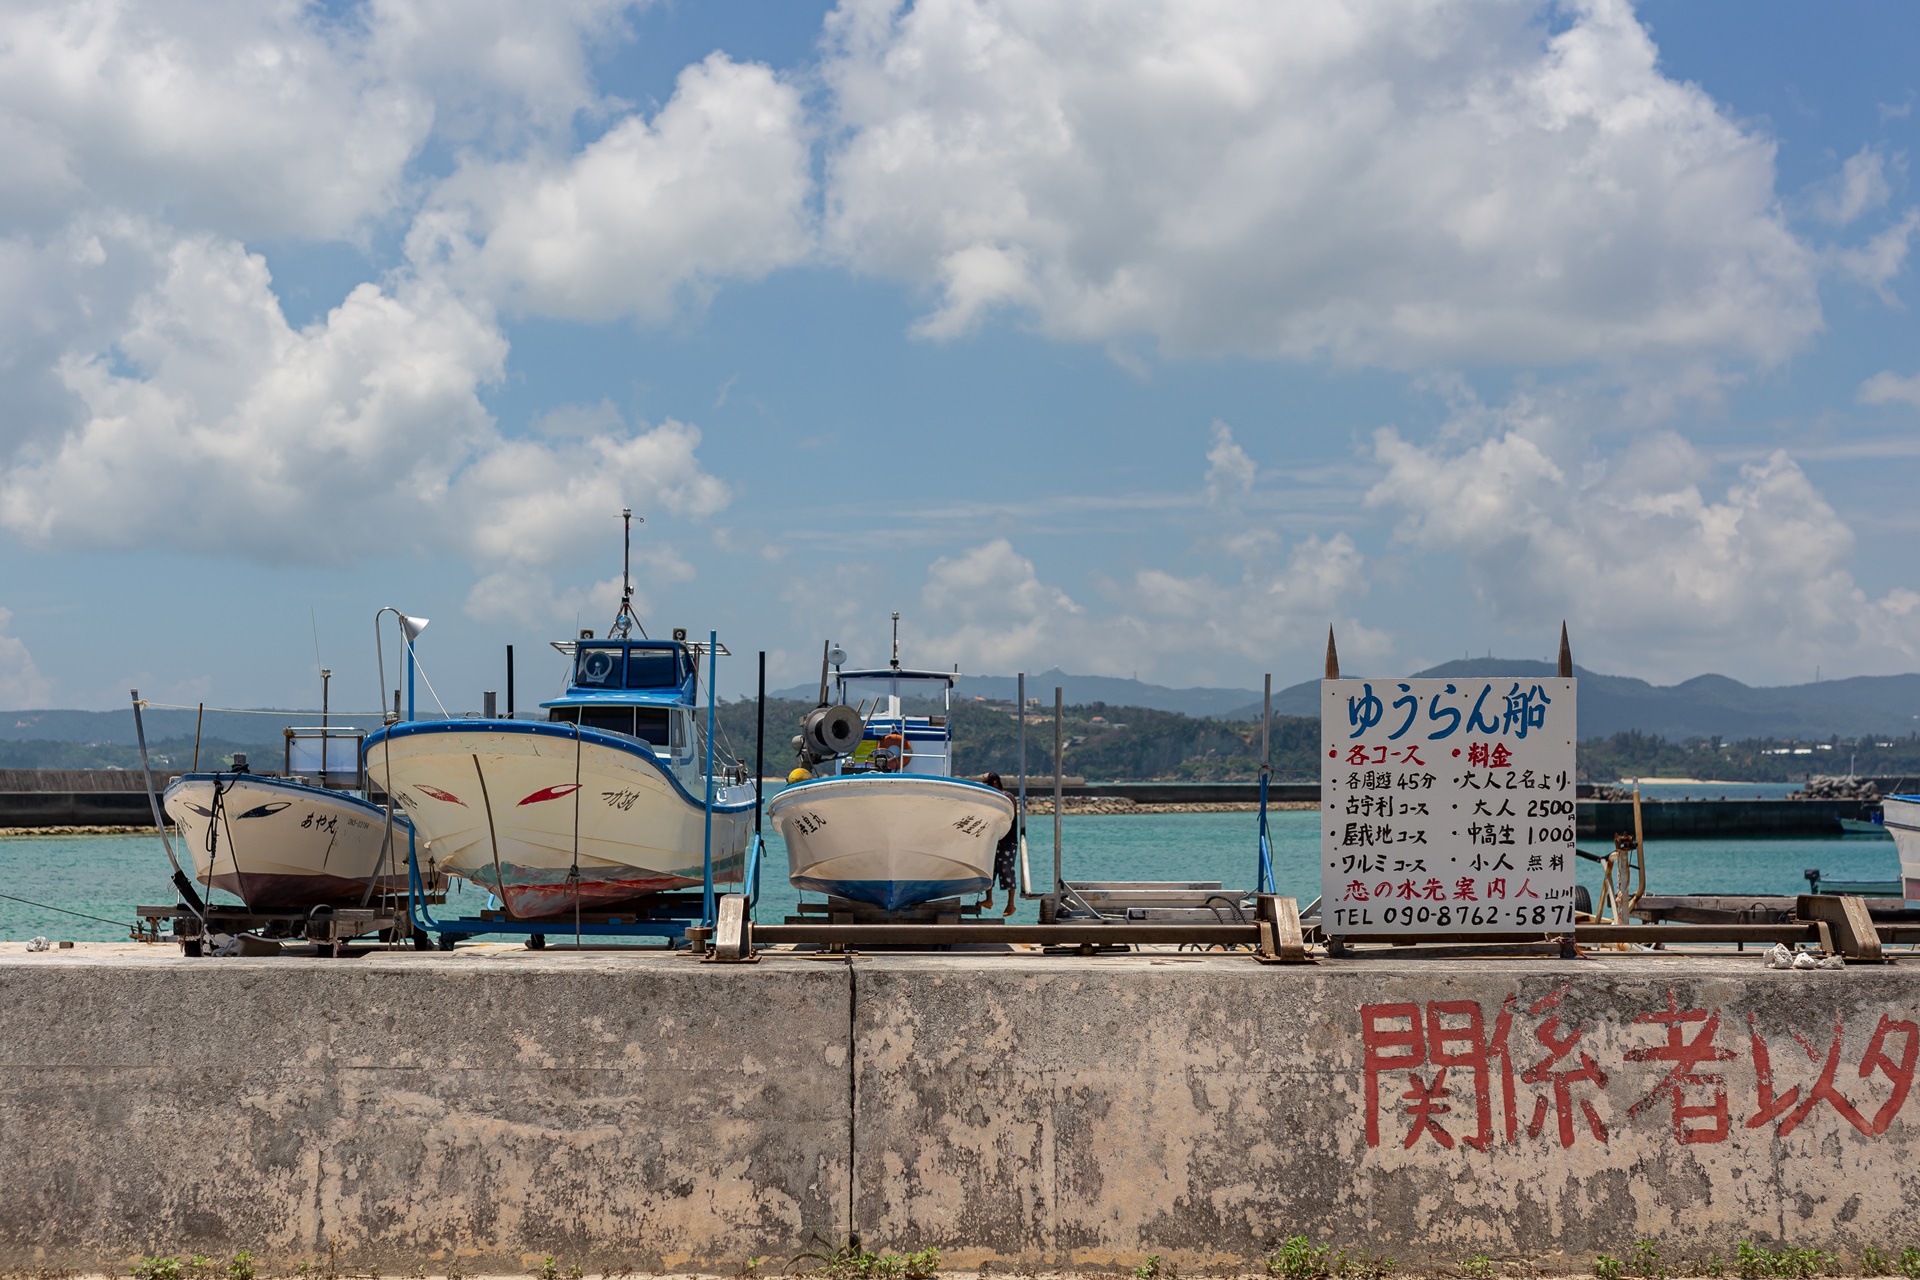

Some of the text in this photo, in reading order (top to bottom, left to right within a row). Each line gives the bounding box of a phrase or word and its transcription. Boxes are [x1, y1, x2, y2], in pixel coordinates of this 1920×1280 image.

[1348, 682, 1551, 740] ゆうらん船
[1345, 744, 1426, 766] 各コース
[1467, 742, 1513, 769] 料金
[1459, 769, 1567, 791] 大人2名より
[1471, 799, 1516, 817] 大人
[1467, 821, 1516, 846] 中高生
[1469, 853, 1565, 873] 小人 無料
[1343, 876, 1540, 902] 恋の水先案内人
[1334, 904, 1574, 927] TEL 090-8762-5871
